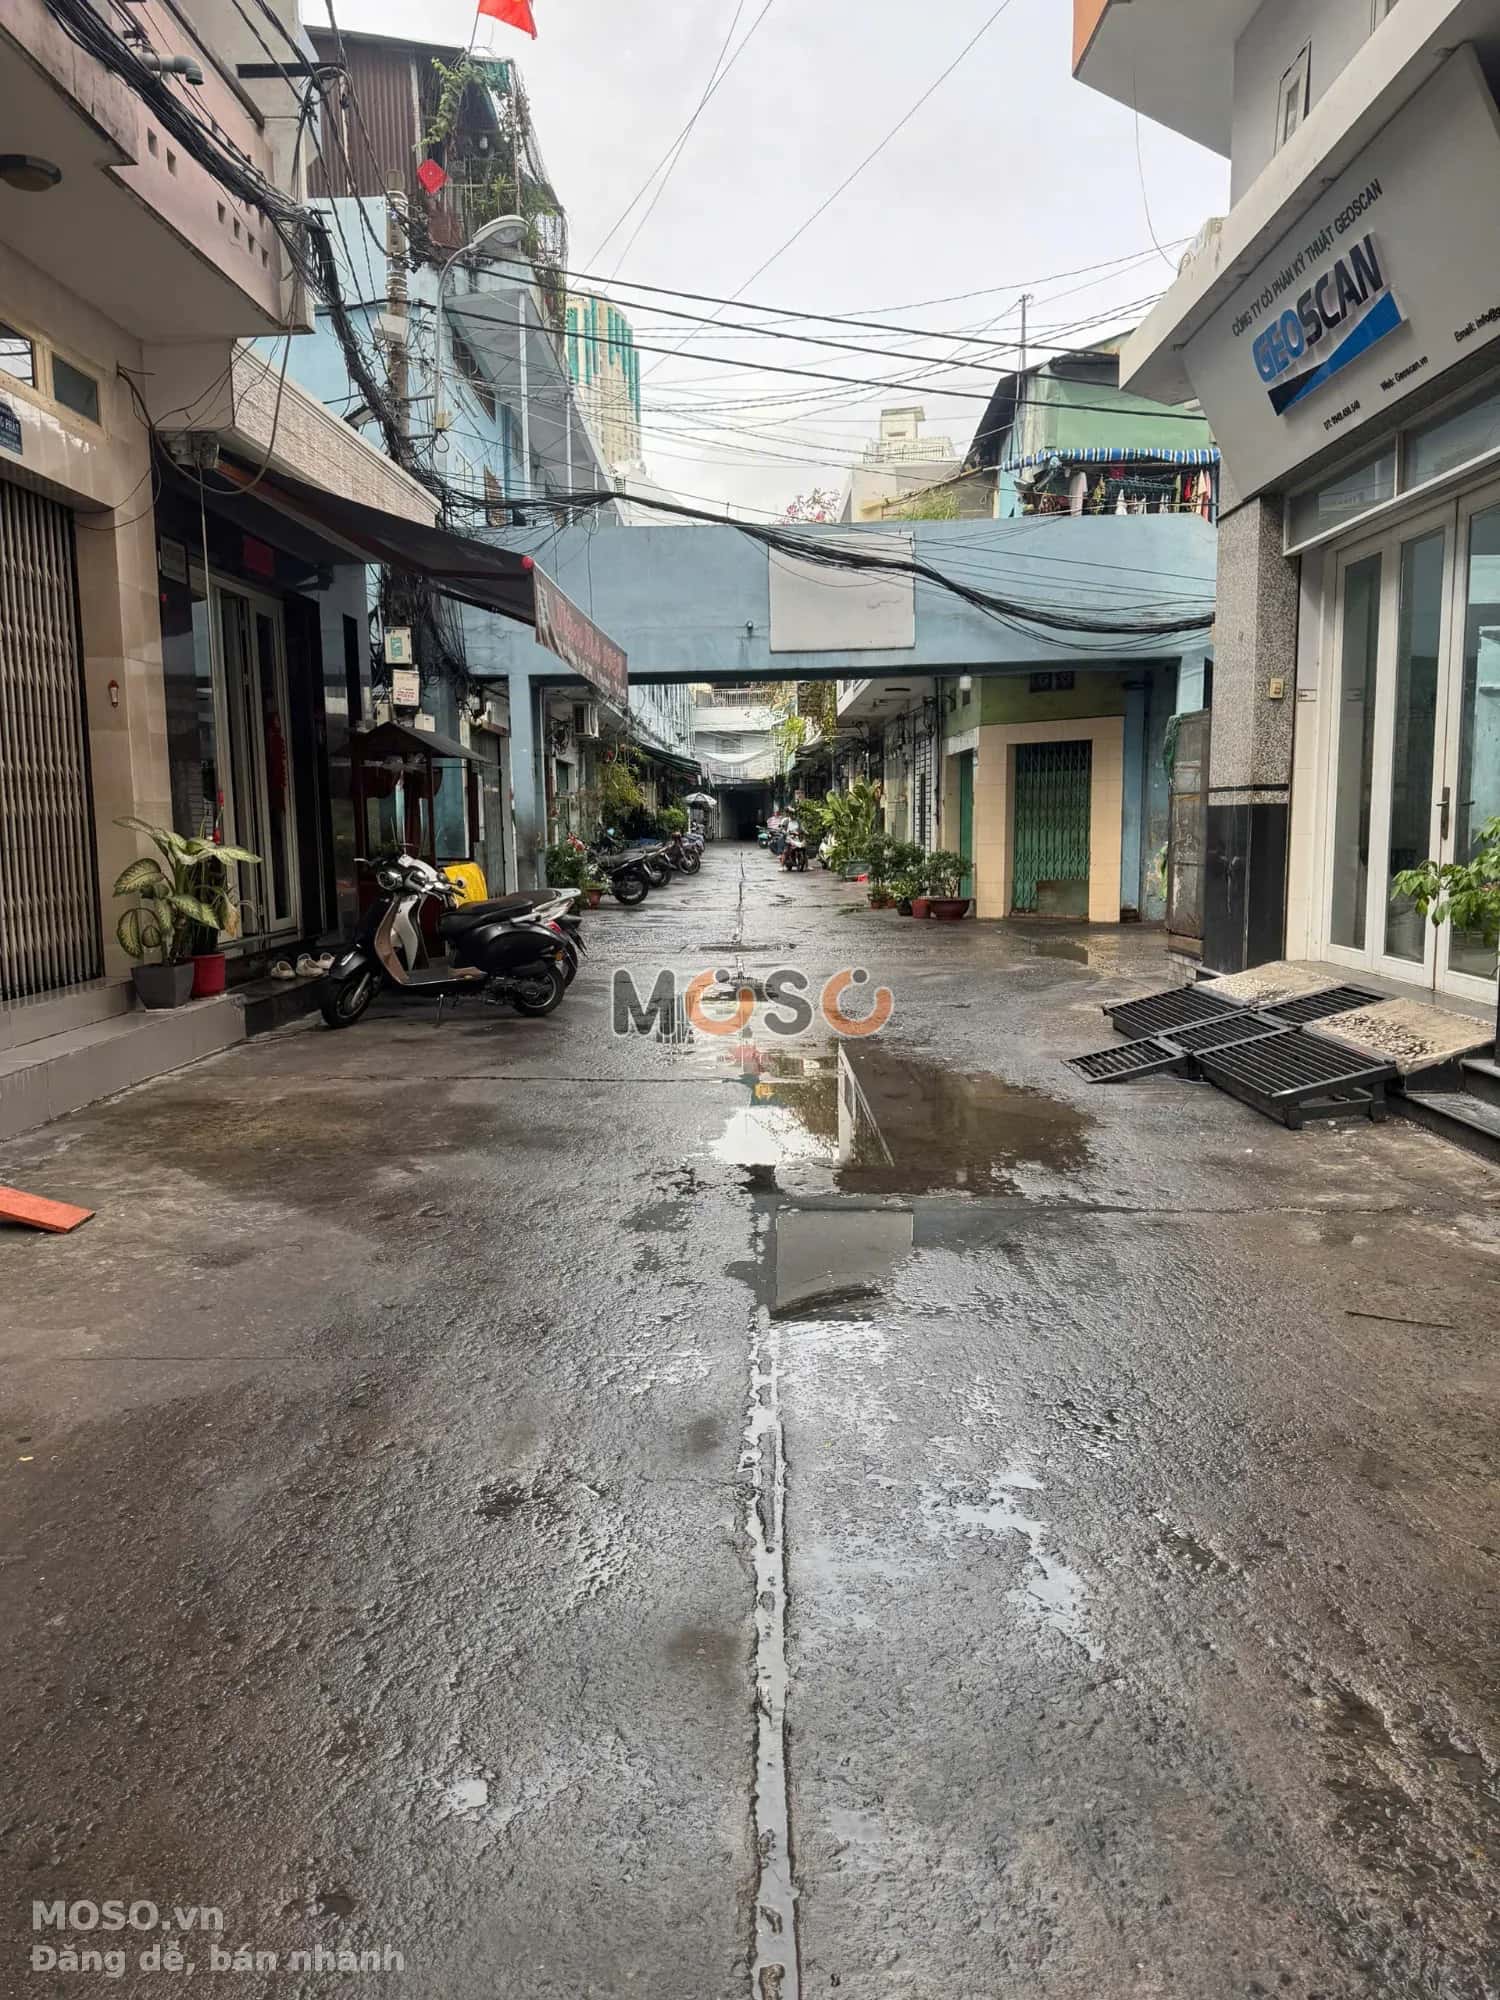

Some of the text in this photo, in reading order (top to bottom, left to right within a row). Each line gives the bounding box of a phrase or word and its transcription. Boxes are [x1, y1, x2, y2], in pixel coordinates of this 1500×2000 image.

[1232, 311, 1252, 336] CÔNG
[1250, 298, 1262, 320] TY
[1305, 225, 1335, 264] THUẬT
[1334, 178, 1384, 235] GEOSCAN
[1252, 232, 1384, 384] GEOSCAN
